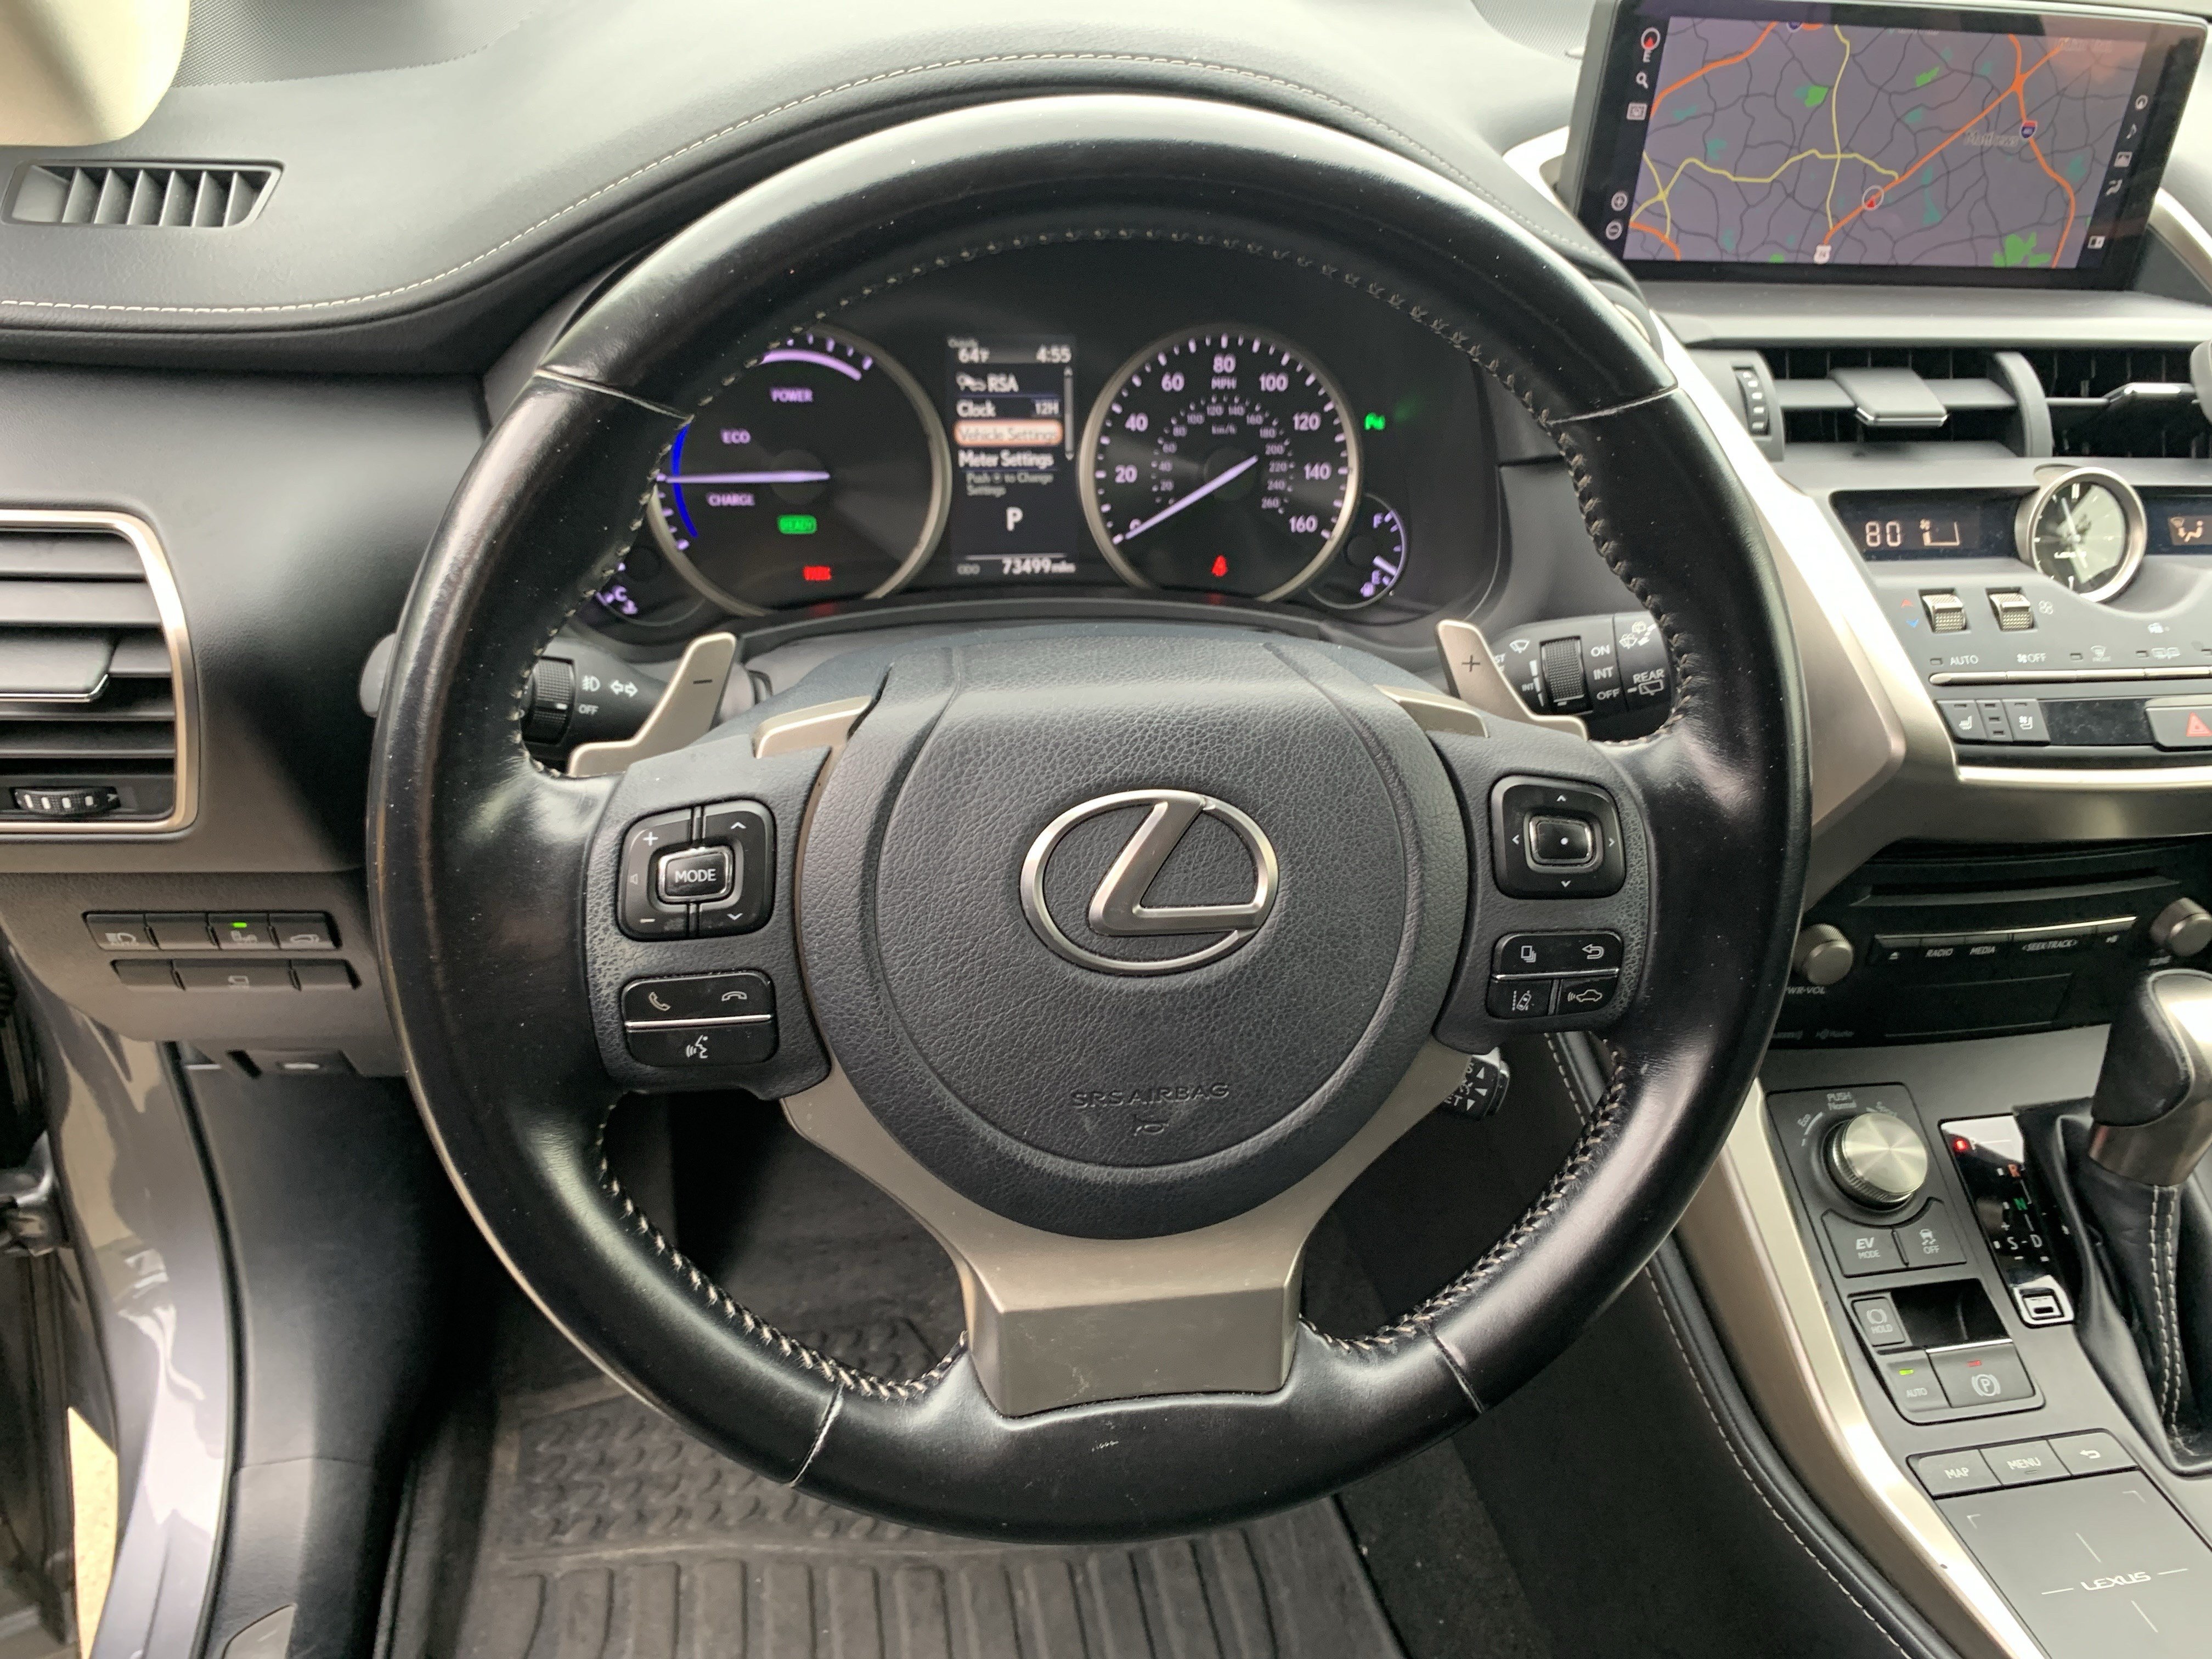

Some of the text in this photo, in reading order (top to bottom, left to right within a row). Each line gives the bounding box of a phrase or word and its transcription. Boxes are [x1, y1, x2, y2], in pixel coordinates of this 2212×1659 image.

[1036, 345, 1071, 363] 4:55
[1213, 354, 1236, 374] 80
[988, 374, 1019, 393] RSA
[1161, 372, 1185, 392] 60
[1211, 376, 1237, 390] MPH
[1260, 373, 1289, 392] 100
[770, 388, 813, 403] POWER
[957, 399, 997, 417] Clock
[1207, 404, 1224, 417] 120
[1228, 404, 1246, 416] 140
[1125, 413, 1149, 432] 40
[1187, 413, 1205, 425] 100
[1246, 413, 1264, 426] 160
[1293, 412, 1322, 432] 120
[1173, 425, 1187, 437] 80
[1211, 423, 1237, 435] km/h
[1260, 426, 1277, 439] 180
[721, 430, 751, 445] ECO
[1163, 441, 1178, 454] 60
[1265, 442, 1285, 455] 200
[958, 449, 1054, 470] Meter Settings
[1159, 460, 1173, 472] 40
[1269, 461, 1288, 473] 220
[1304, 462, 1331, 481] 140
[1115, 465, 1138, 484] 20
[1160, 478, 1175, 492] 20
[1267, 478, 1287, 490] 240
[707, 494, 756, 507] CHARGE
[1262, 495, 1281, 510] 260
[1006, 506, 1024, 532] P
[1289, 515, 1318, 534] 160
[1373, 511, 1384, 528] F
[1865, 521, 1901, 548] 80
[1002, 556, 1052, 574] 73499
[1590, 644, 1610, 657] ON
[1950, 653, 1979, 666] AUTO
[2027, 652, 2047, 664] OFF
[1593, 665, 1613, 681] INT
[1633, 668, 1664, 685] REAR
[1596, 687, 1621, 701] OFF
[578, 704, 599, 715] OFF
[674, 868, 717, 883] MODE
[1925, 948, 1954, 958] RADIO
[1970, 945, 1996, 956] MEDIA
[1072, 1082, 1230, 1108] SRS AIRBAG
[1827, 1091, 1852, 1103] PUSH
[2008, 1164, 2021, 1178] R
[2013, 1197, 2028, 1211] N
[1856, 1237, 1875, 1250] EV
[2007, 1236, 2019, 1250] S
[2030, 1234, 2042, 1249] D
[1858, 1249, 1881, 1260] MODE
[1922, 1245, 1940, 1255] OFF
[1871, 1324, 1893, 1335] HOLD
[1905, 1386, 1928, 1398] AUTO
[2006, 1456, 2042, 1471] MENU
[1944, 1466, 1970, 1480] MAP
[2080, 1570, 2152, 1591] LEXUS
